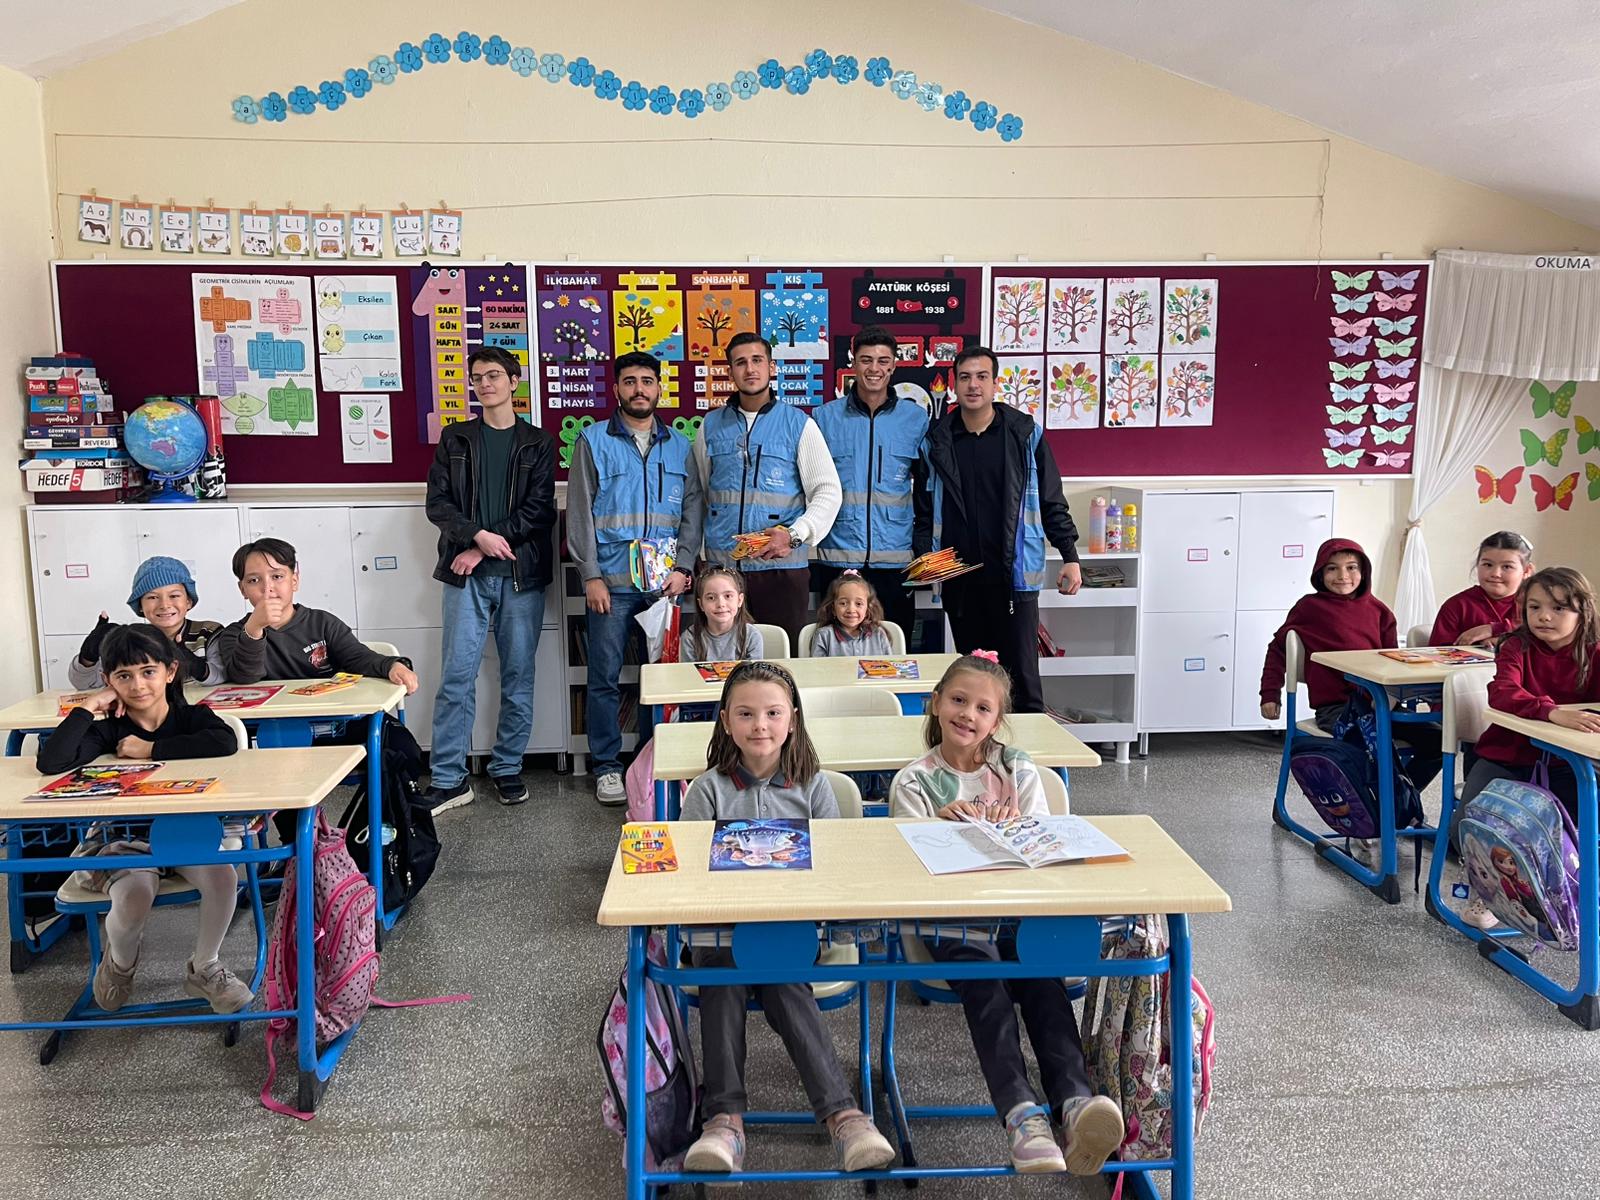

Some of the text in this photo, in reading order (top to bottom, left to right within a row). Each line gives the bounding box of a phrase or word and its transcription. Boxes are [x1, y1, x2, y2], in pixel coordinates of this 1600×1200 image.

[243, 106, 249, 114] a
[272, 102, 279, 112] b
[354, 78, 361, 88] d
[380, 66, 386, 74] e
[408, 54, 412, 62] f
[434, 44, 440, 54] g
[494, 46, 500, 56] h
[604, 81, 611, 90] k
[742, 80, 749, 89] ö
[769, 70, 776, 80] p
[816, 60, 822, 68] s
[1536, 256, 1591, 269] OKUMA
[546, 274, 598, 286] İLKBAHAR
[639, 276, 658, 284] YAZ
[694, 275, 745, 285] SONBAHAR
[786, 275, 802, 285] KIŞ
[868, 282, 950, 294] ATATÜRK KÖŞESİ
[358, 296, 384, 304] Eksilen
[438, 306, 458, 314] SAAT
[498, 304, 526, 314] DAKİKA
[440, 322, 456, 330] GÜN
[362, 334, 384, 342] Çıkan
[500, 336, 516, 346] GÜN
[436, 338, 461, 347] HAFTA
[444, 354, 456, 362] AY
[562, 368, 590, 376] MART
[776, 366, 811, 374] ARALIK
[380, 378, 396, 386] Fark
[780, 382, 809, 390] OCAK
[444, 384, 458, 392] YIL
[562, 384, 594, 392] NİSAN
[711, 382, 734, 392] EKİM
[444, 400, 459, 408] YIL
[562, 399, 595, 408] MAYIS
[38, 474, 80, 486] HEDEF 5
[104, 472, 122, 487] HEDEF
